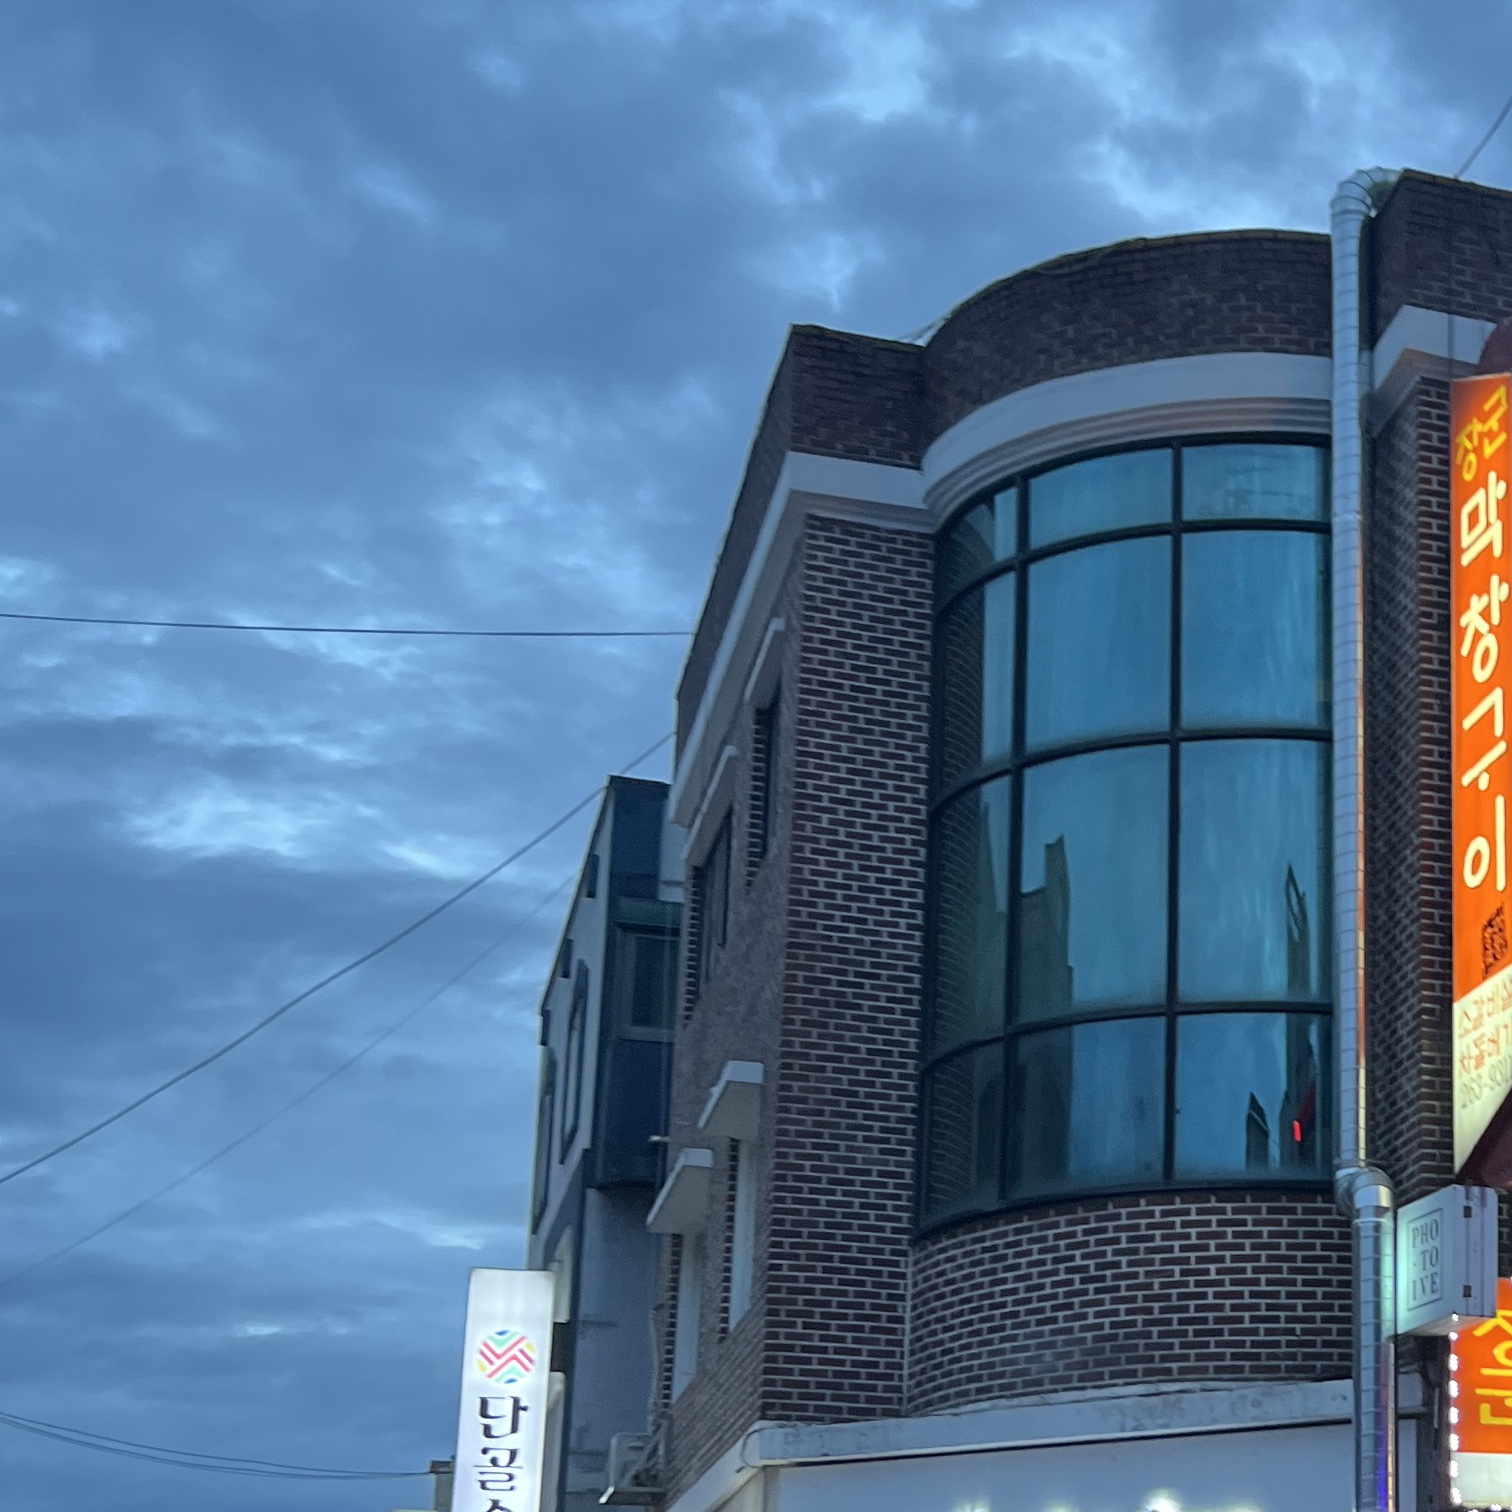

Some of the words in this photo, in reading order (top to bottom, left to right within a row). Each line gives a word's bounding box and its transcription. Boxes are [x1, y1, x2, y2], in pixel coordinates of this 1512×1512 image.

[1454, 383, 1510, 482] 장군
[1459, 472, 1511, 892] 막창구이
[1411, 1219, 1439, 1249] PHO
[1421, 1246, 1439, 1272] TO
[1411, 1272, 1439, 1302] IVE
